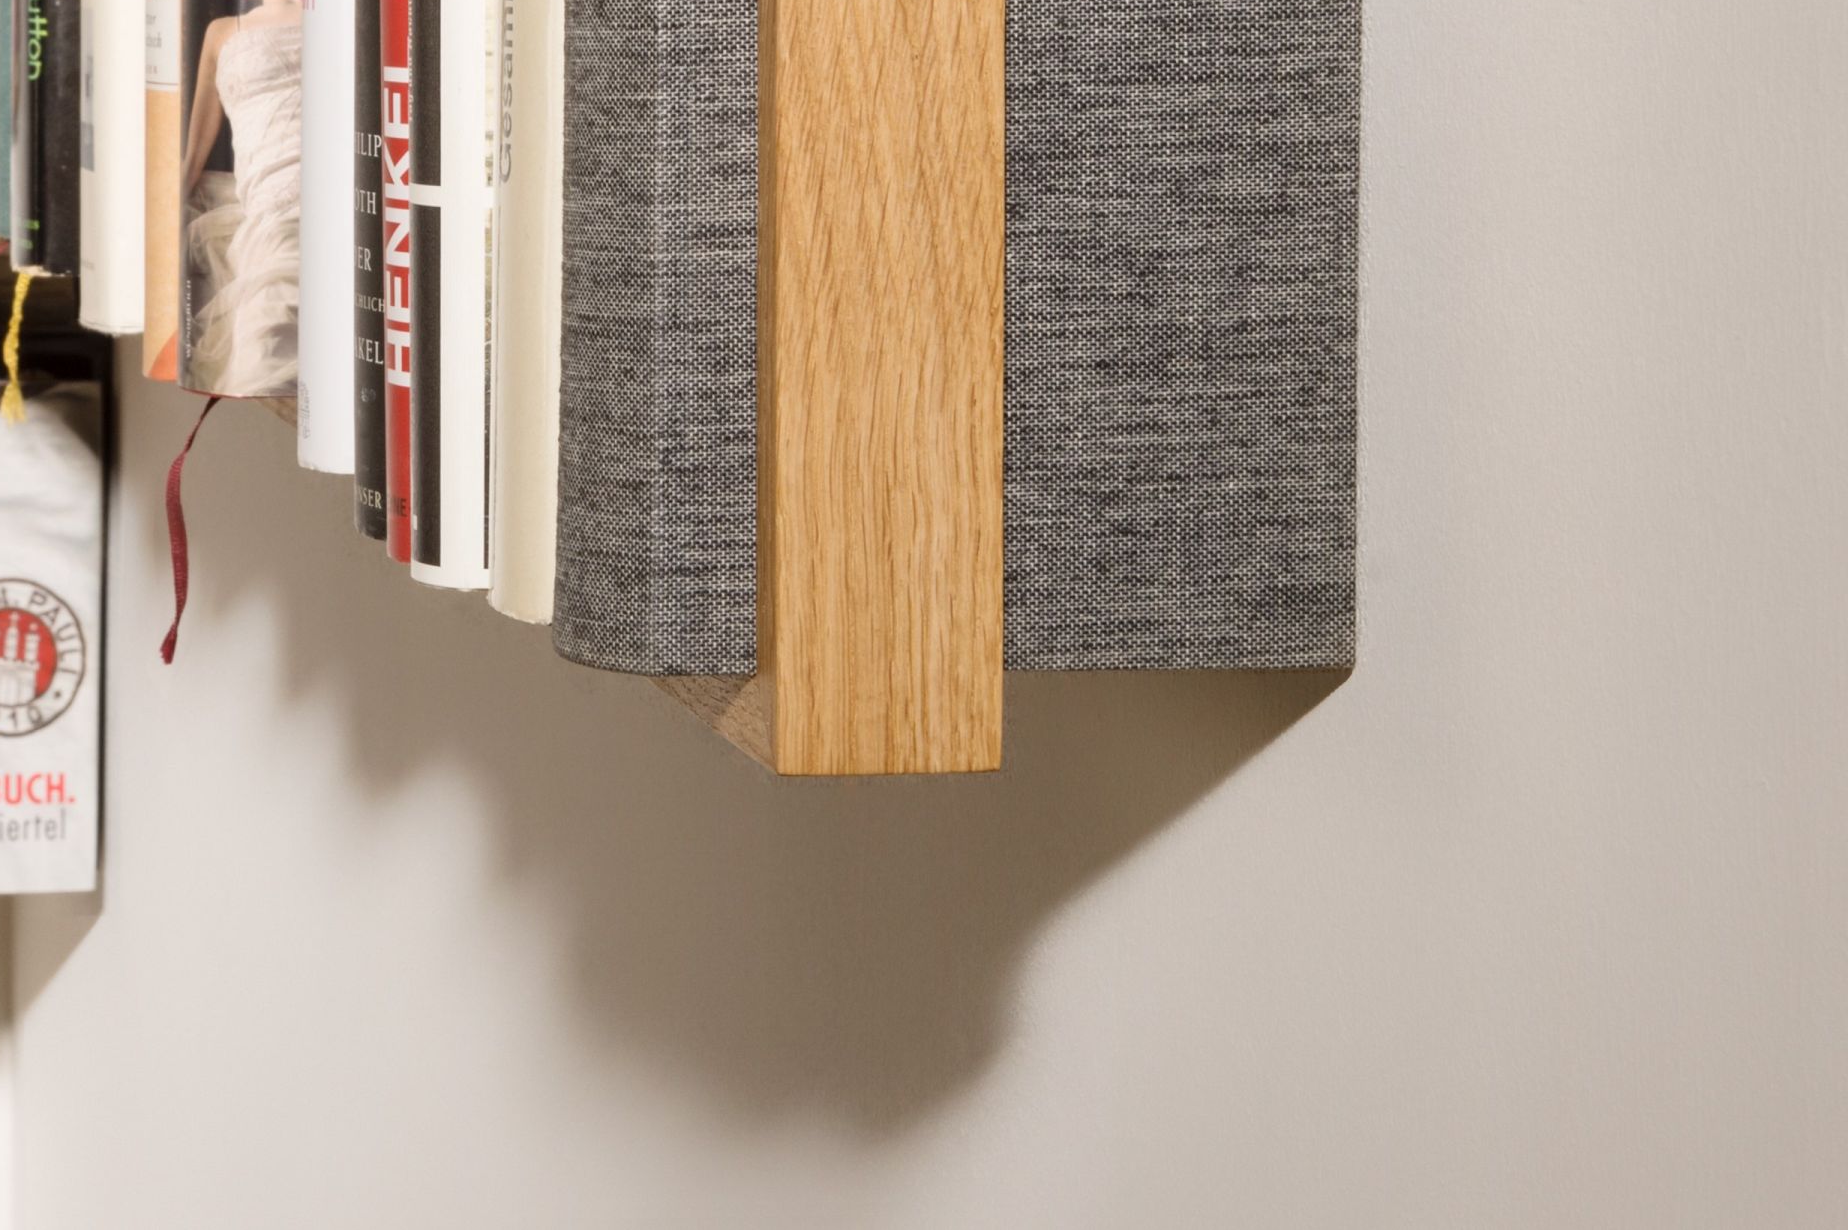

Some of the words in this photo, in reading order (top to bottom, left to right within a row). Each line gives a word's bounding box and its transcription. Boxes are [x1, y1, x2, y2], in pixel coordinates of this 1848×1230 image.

[384, 36, 412, 388] HENKEL
[355, 245, 373, 272] ER
[28, 590, 79, 675] PAULI
